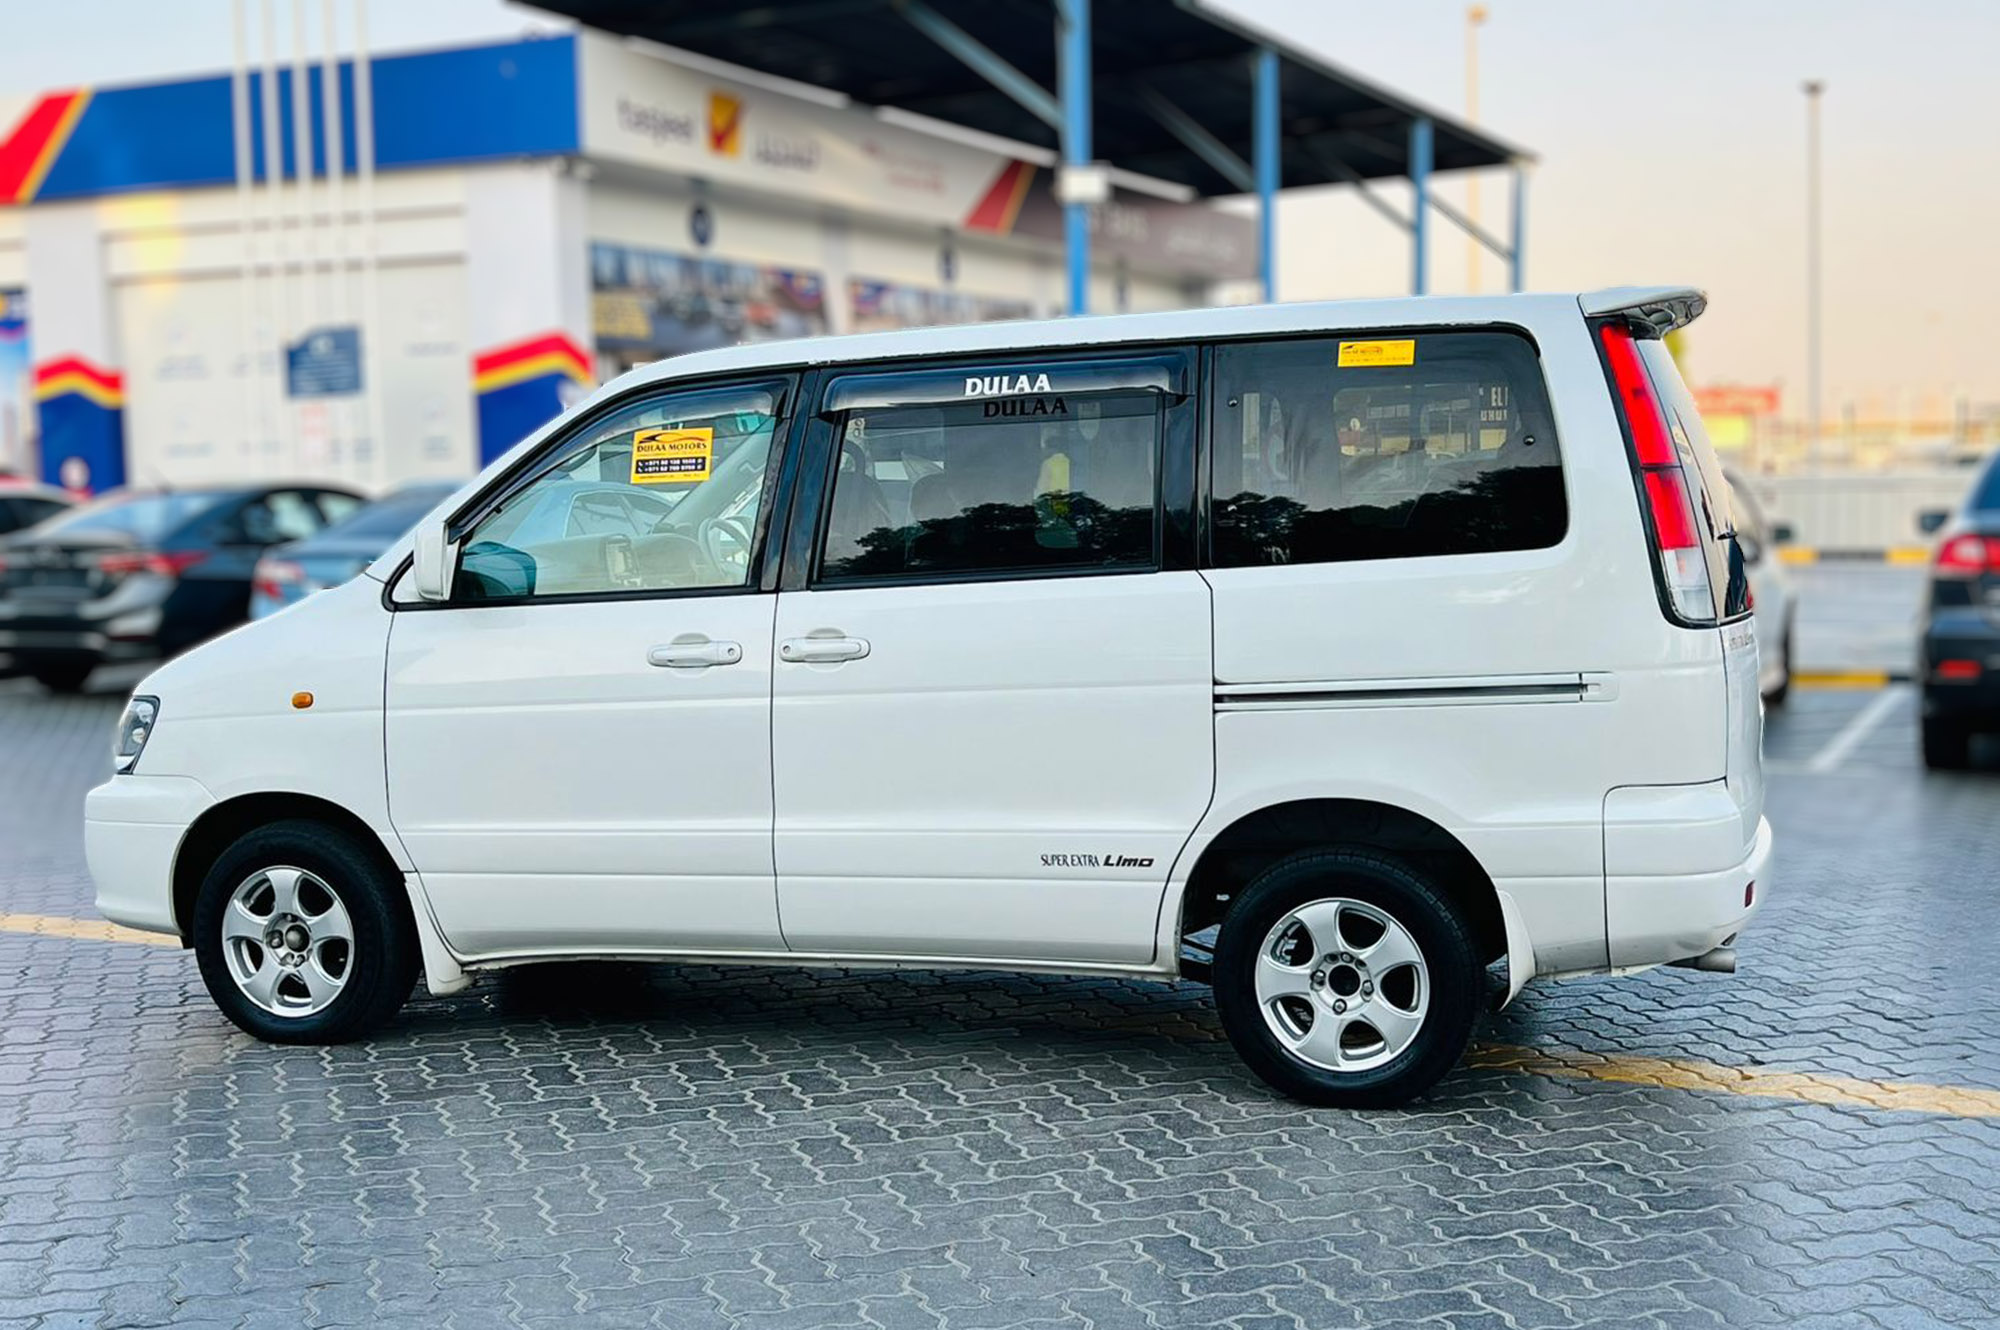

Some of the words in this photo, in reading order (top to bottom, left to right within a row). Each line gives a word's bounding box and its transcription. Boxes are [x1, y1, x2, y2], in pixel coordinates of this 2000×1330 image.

[964, 373, 1052, 397] DULAA
[984, 397, 1067, 418] DULAA
[637, 444, 666, 452] DULAA
[669, 442, 707, 450] MOTORS
[1040, 854, 1070, 867] SUPER
[1070, 854, 1100, 867] EXTRA
[1103, 854, 1154, 867] Limo
